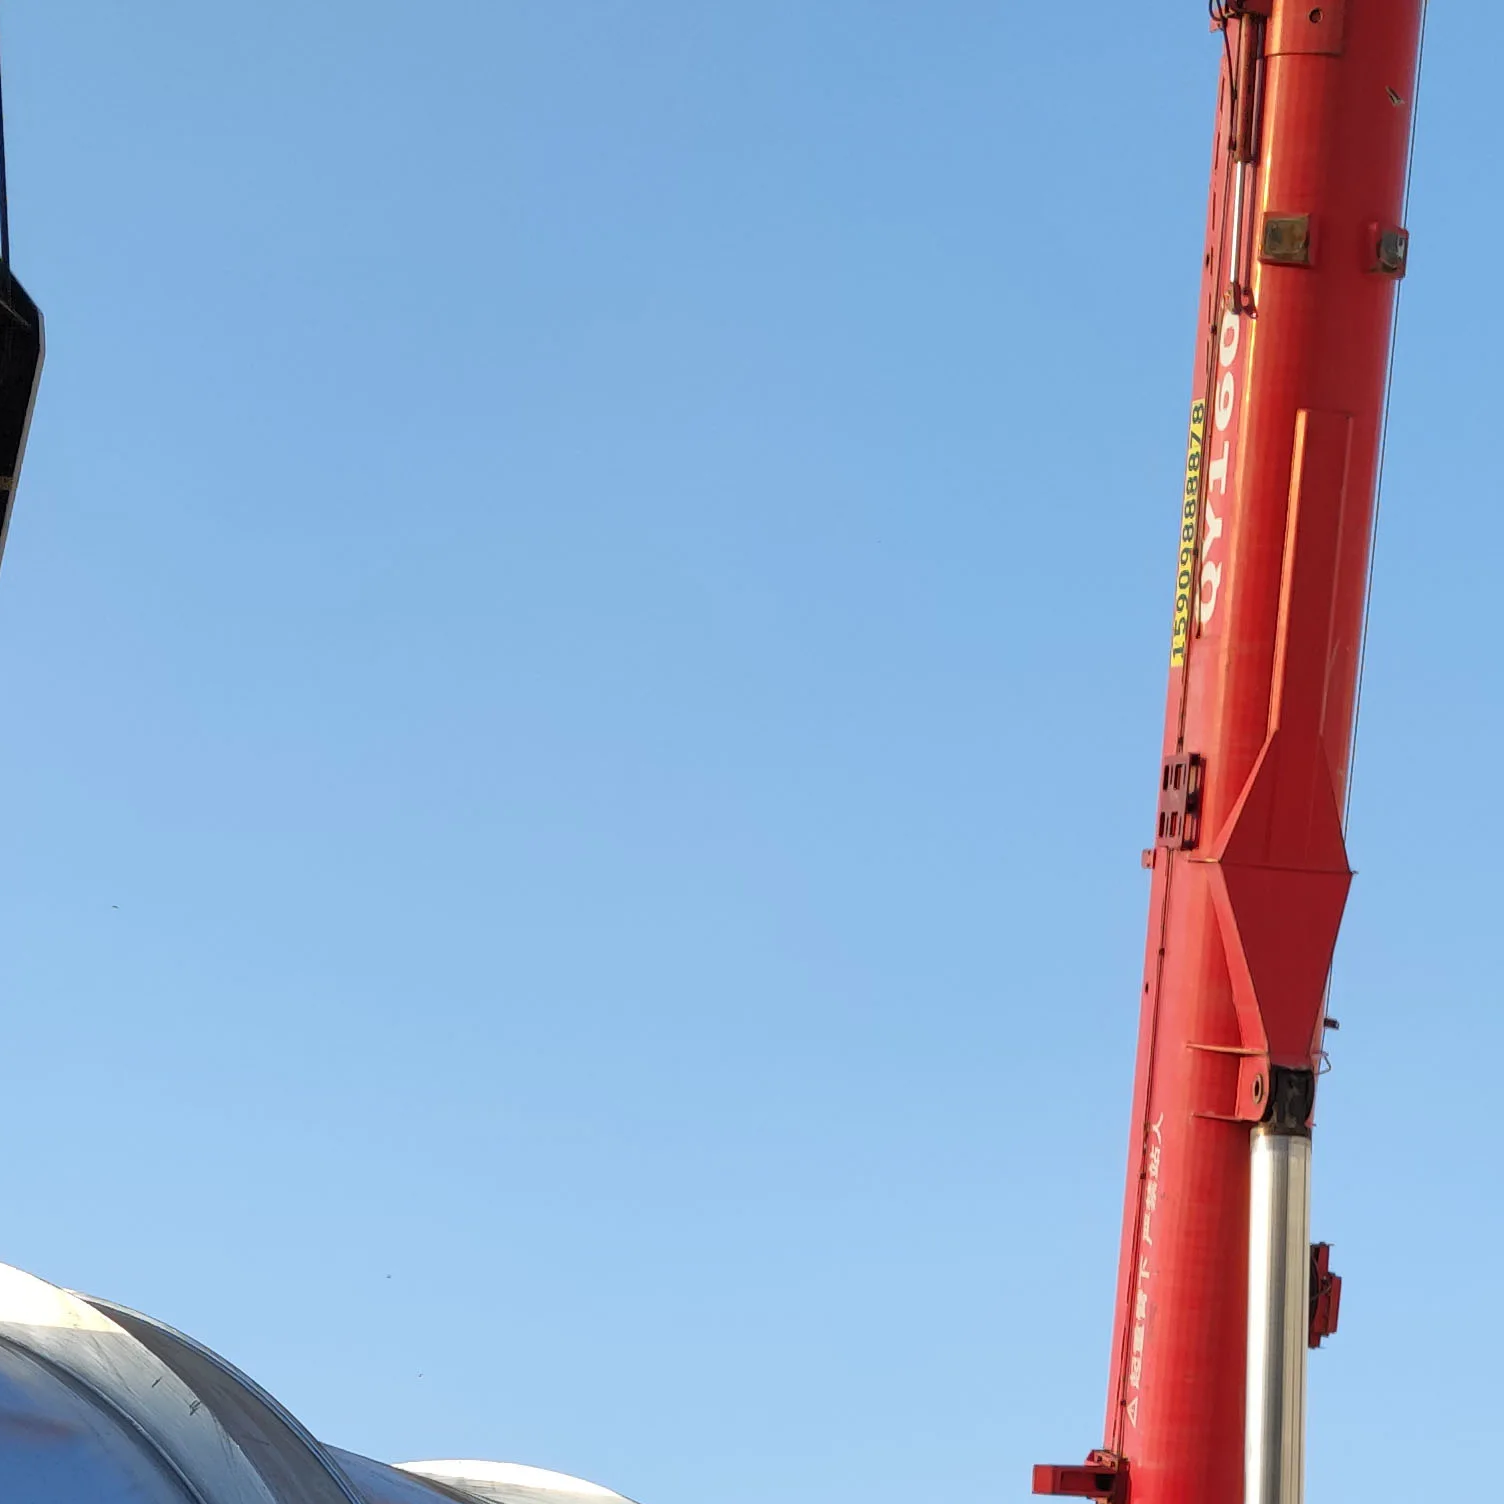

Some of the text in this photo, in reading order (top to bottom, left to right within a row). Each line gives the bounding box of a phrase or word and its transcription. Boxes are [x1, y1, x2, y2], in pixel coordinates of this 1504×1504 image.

[1172, 402, 1204, 660] 15909888878
[1195, 308, 1240, 625] QY160
[1129, 1112, 1163, 1389] 起重臂下 严禁站人
